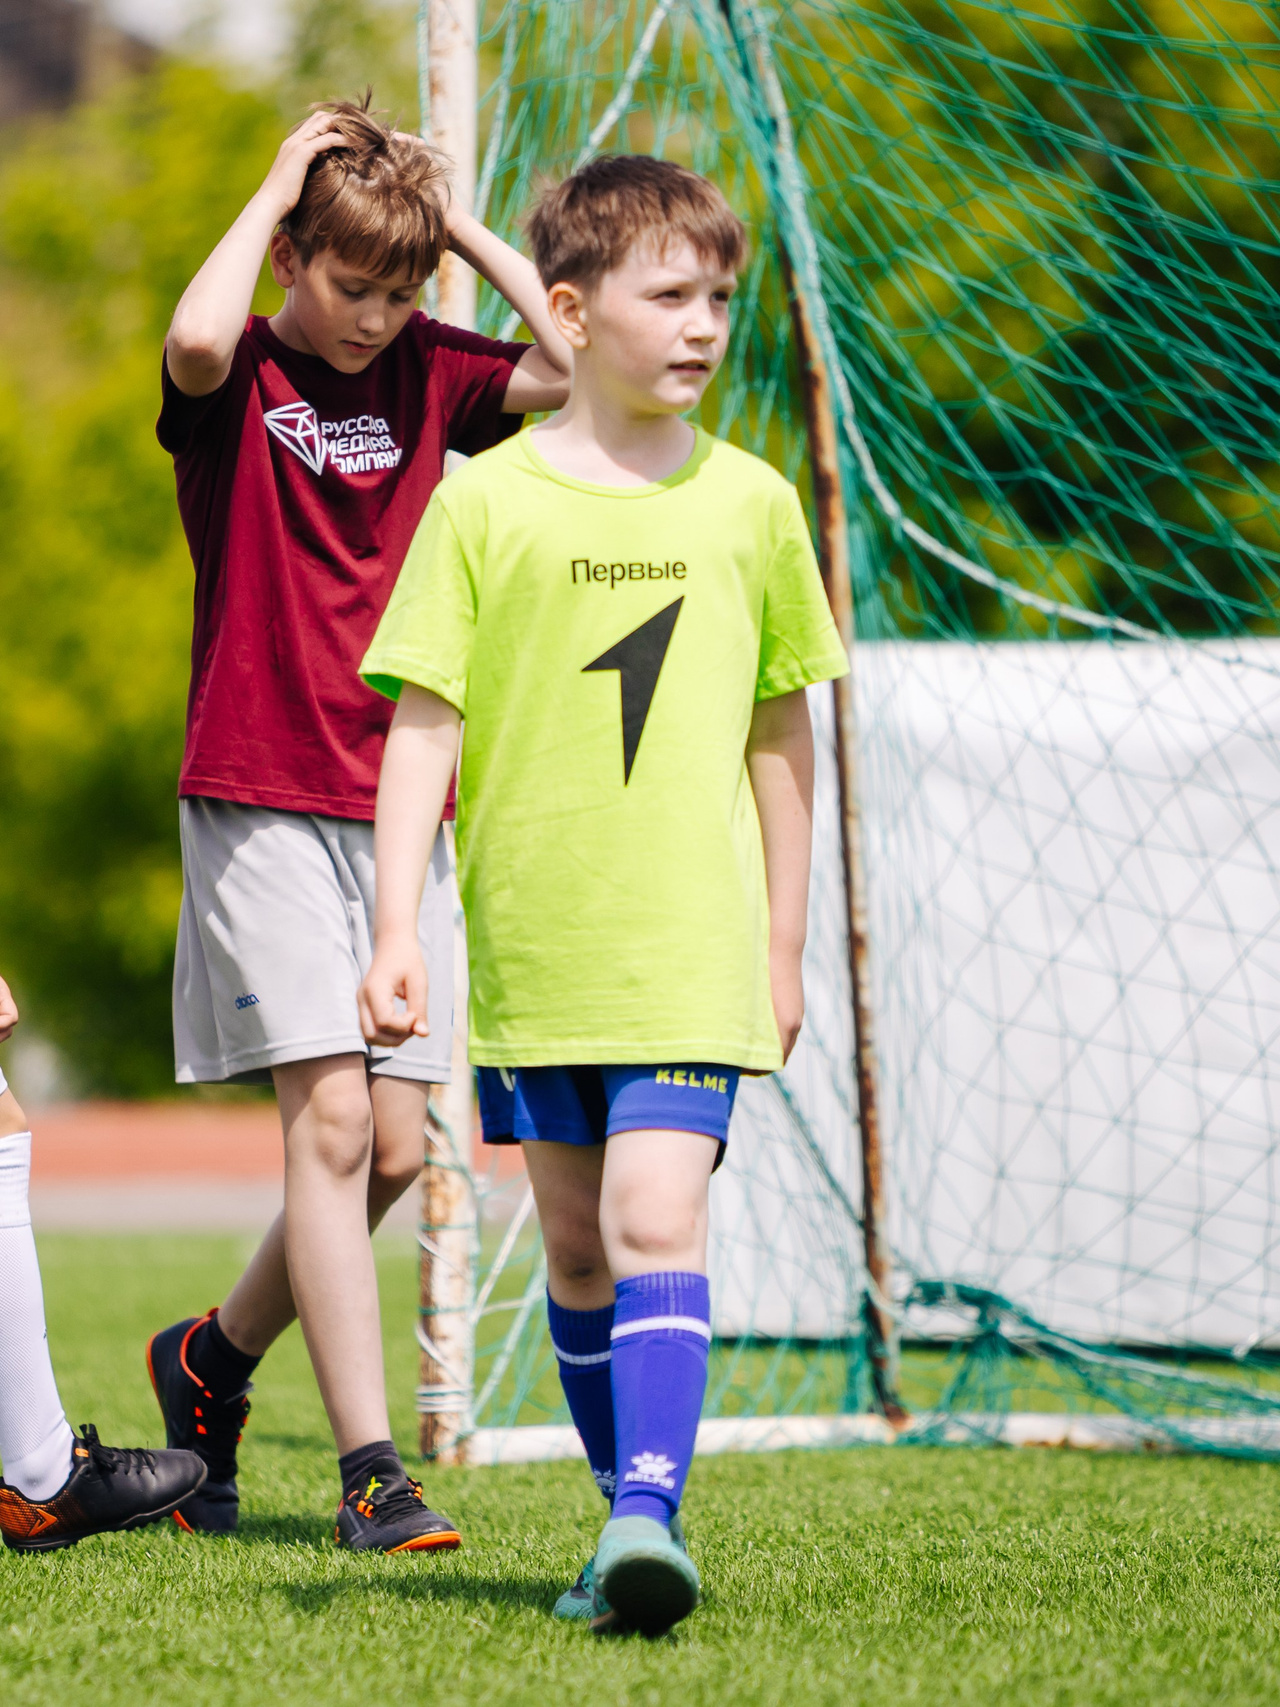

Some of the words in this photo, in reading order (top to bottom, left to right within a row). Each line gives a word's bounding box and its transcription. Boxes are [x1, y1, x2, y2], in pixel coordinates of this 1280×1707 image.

[321, 415, 389, 437] РУССАЯ
[571, 559, 687, 590] Первые
[655, 1069, 728, 1094] KELME
